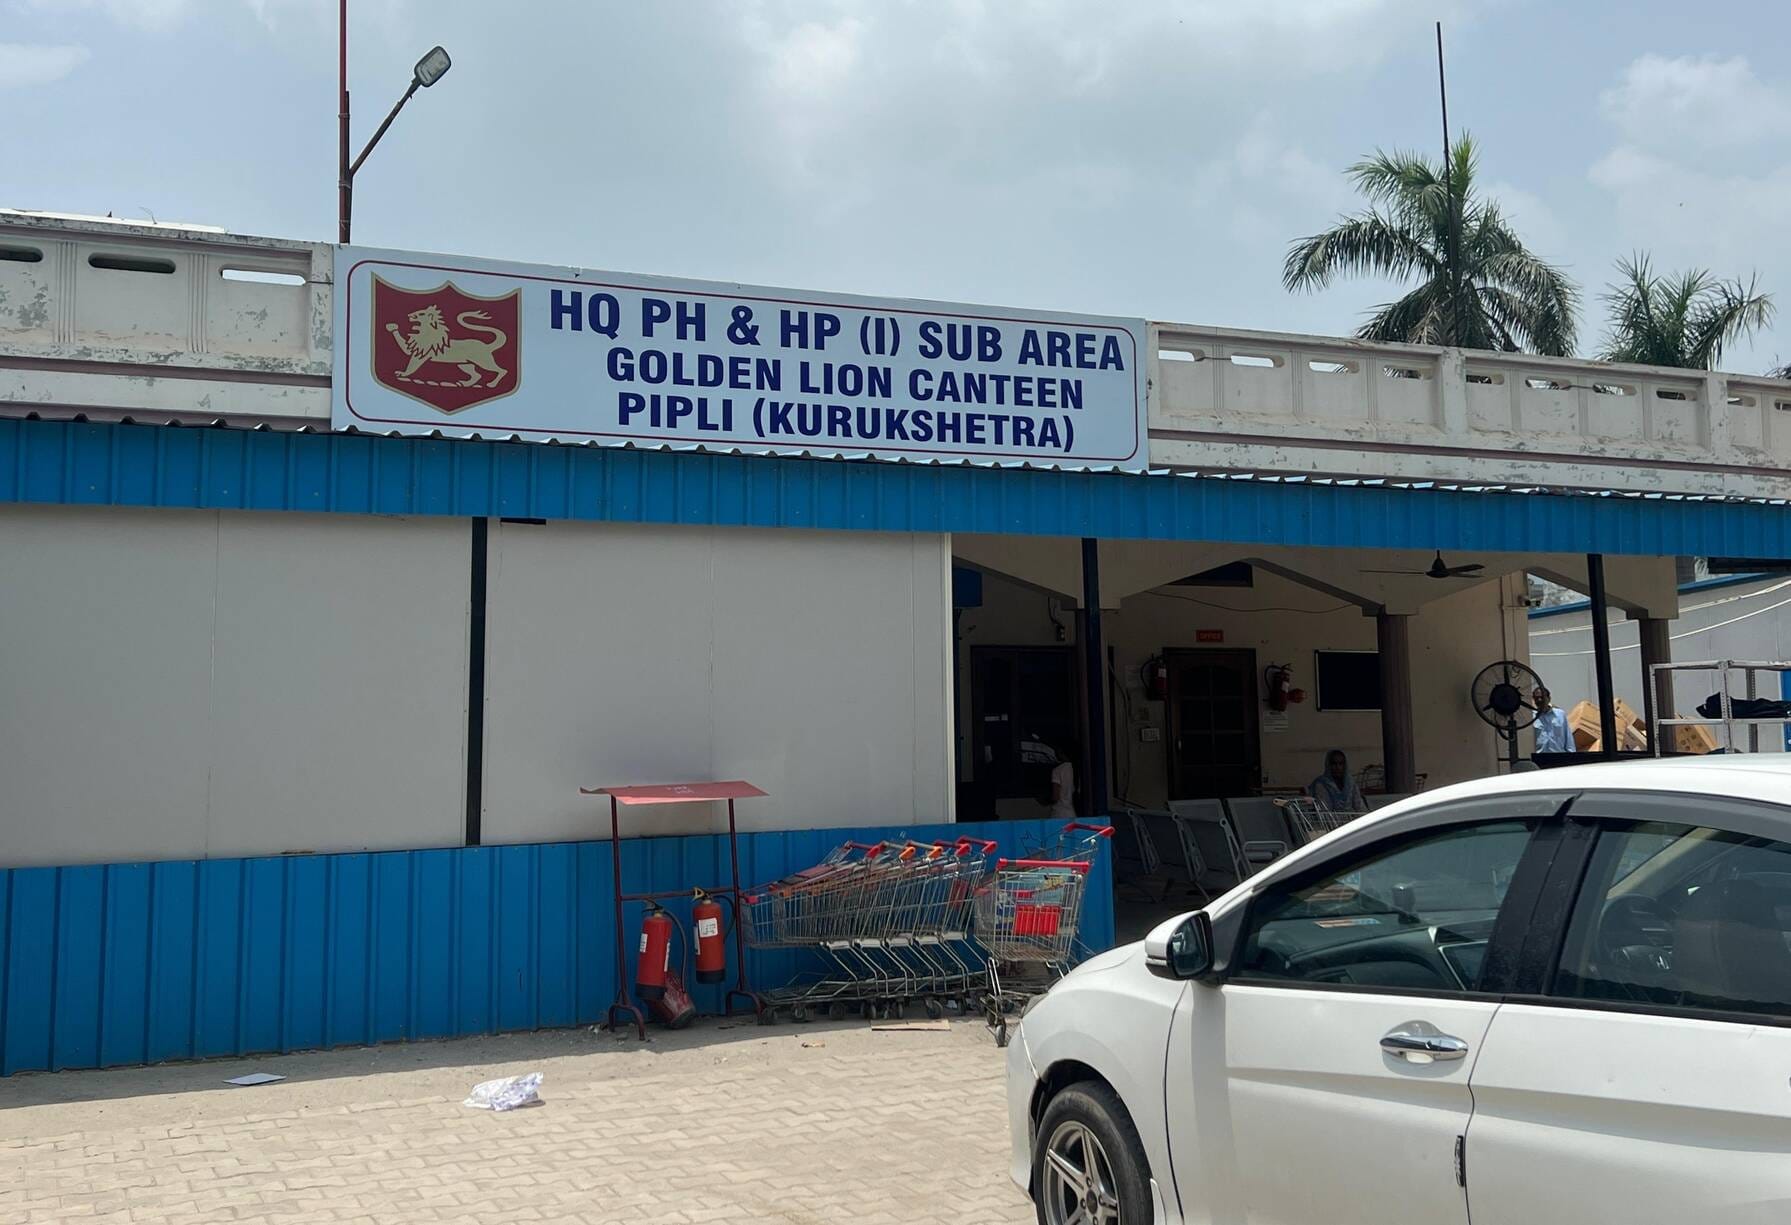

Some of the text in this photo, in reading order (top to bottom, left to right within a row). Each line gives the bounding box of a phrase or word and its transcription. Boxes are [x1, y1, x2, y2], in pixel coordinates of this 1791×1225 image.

[550, 289, 1125, 371] HQ PH & HP (I) SUB AREA
[606, 346, 1084, 410] GOLDEN LION CANTEEN
[618, 391, 1074, 453] PIPLI (KURUKSHETRA)
